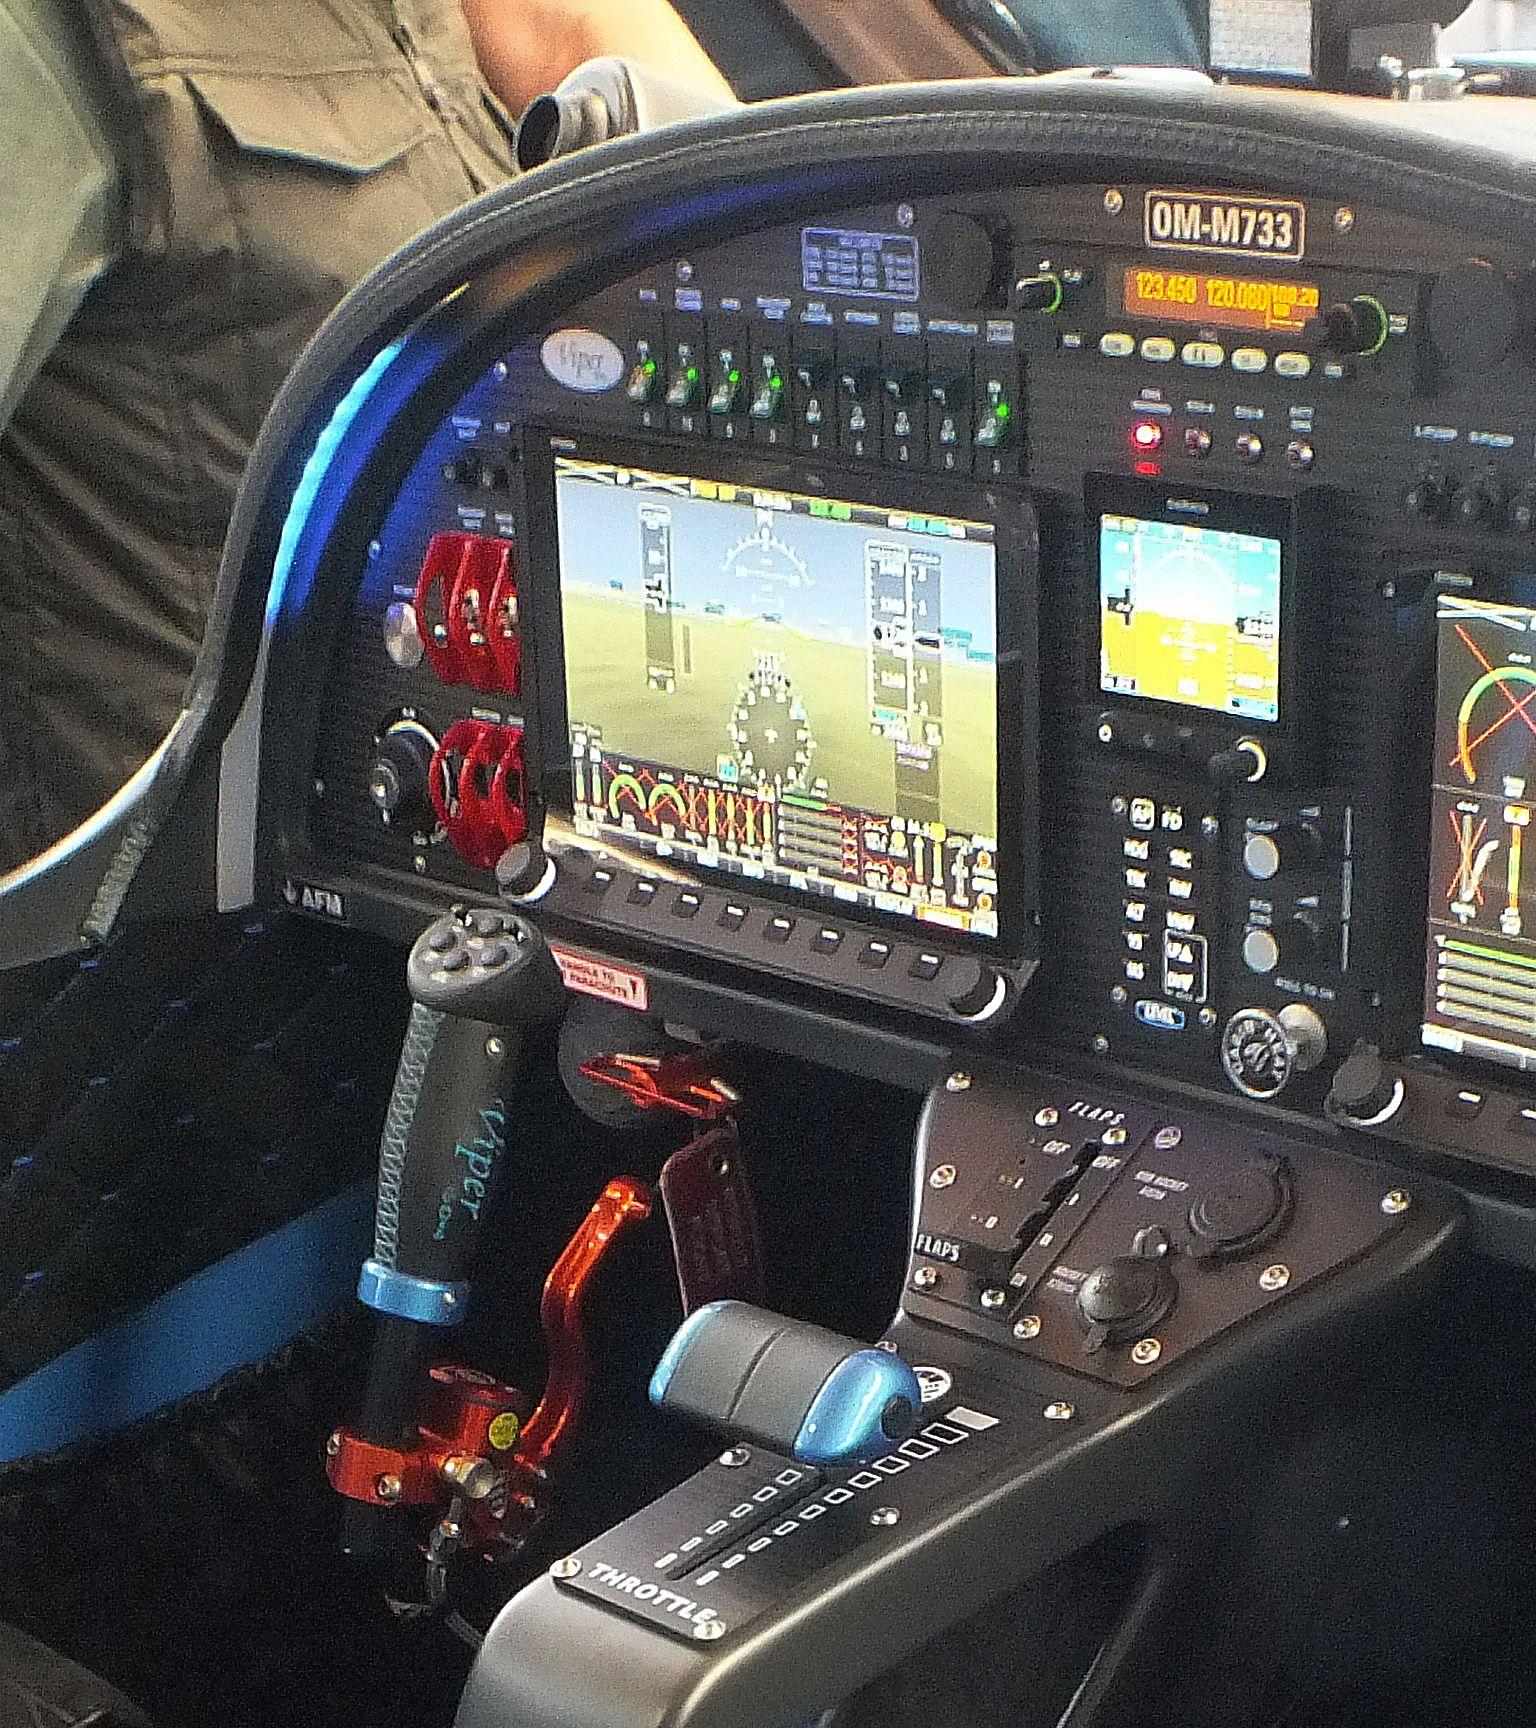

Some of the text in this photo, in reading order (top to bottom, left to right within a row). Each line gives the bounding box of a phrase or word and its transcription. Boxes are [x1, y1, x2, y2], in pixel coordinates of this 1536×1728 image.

[1151, 200, 1293, 249] OM-M733
[1067, 1101, 1127, 1126] FLAPS
[454, 1098, 508, 1222] Viper
[914, 1232, 961, 1263] FLAPS
[587, 1561, 719, 1628] THROTTLE
